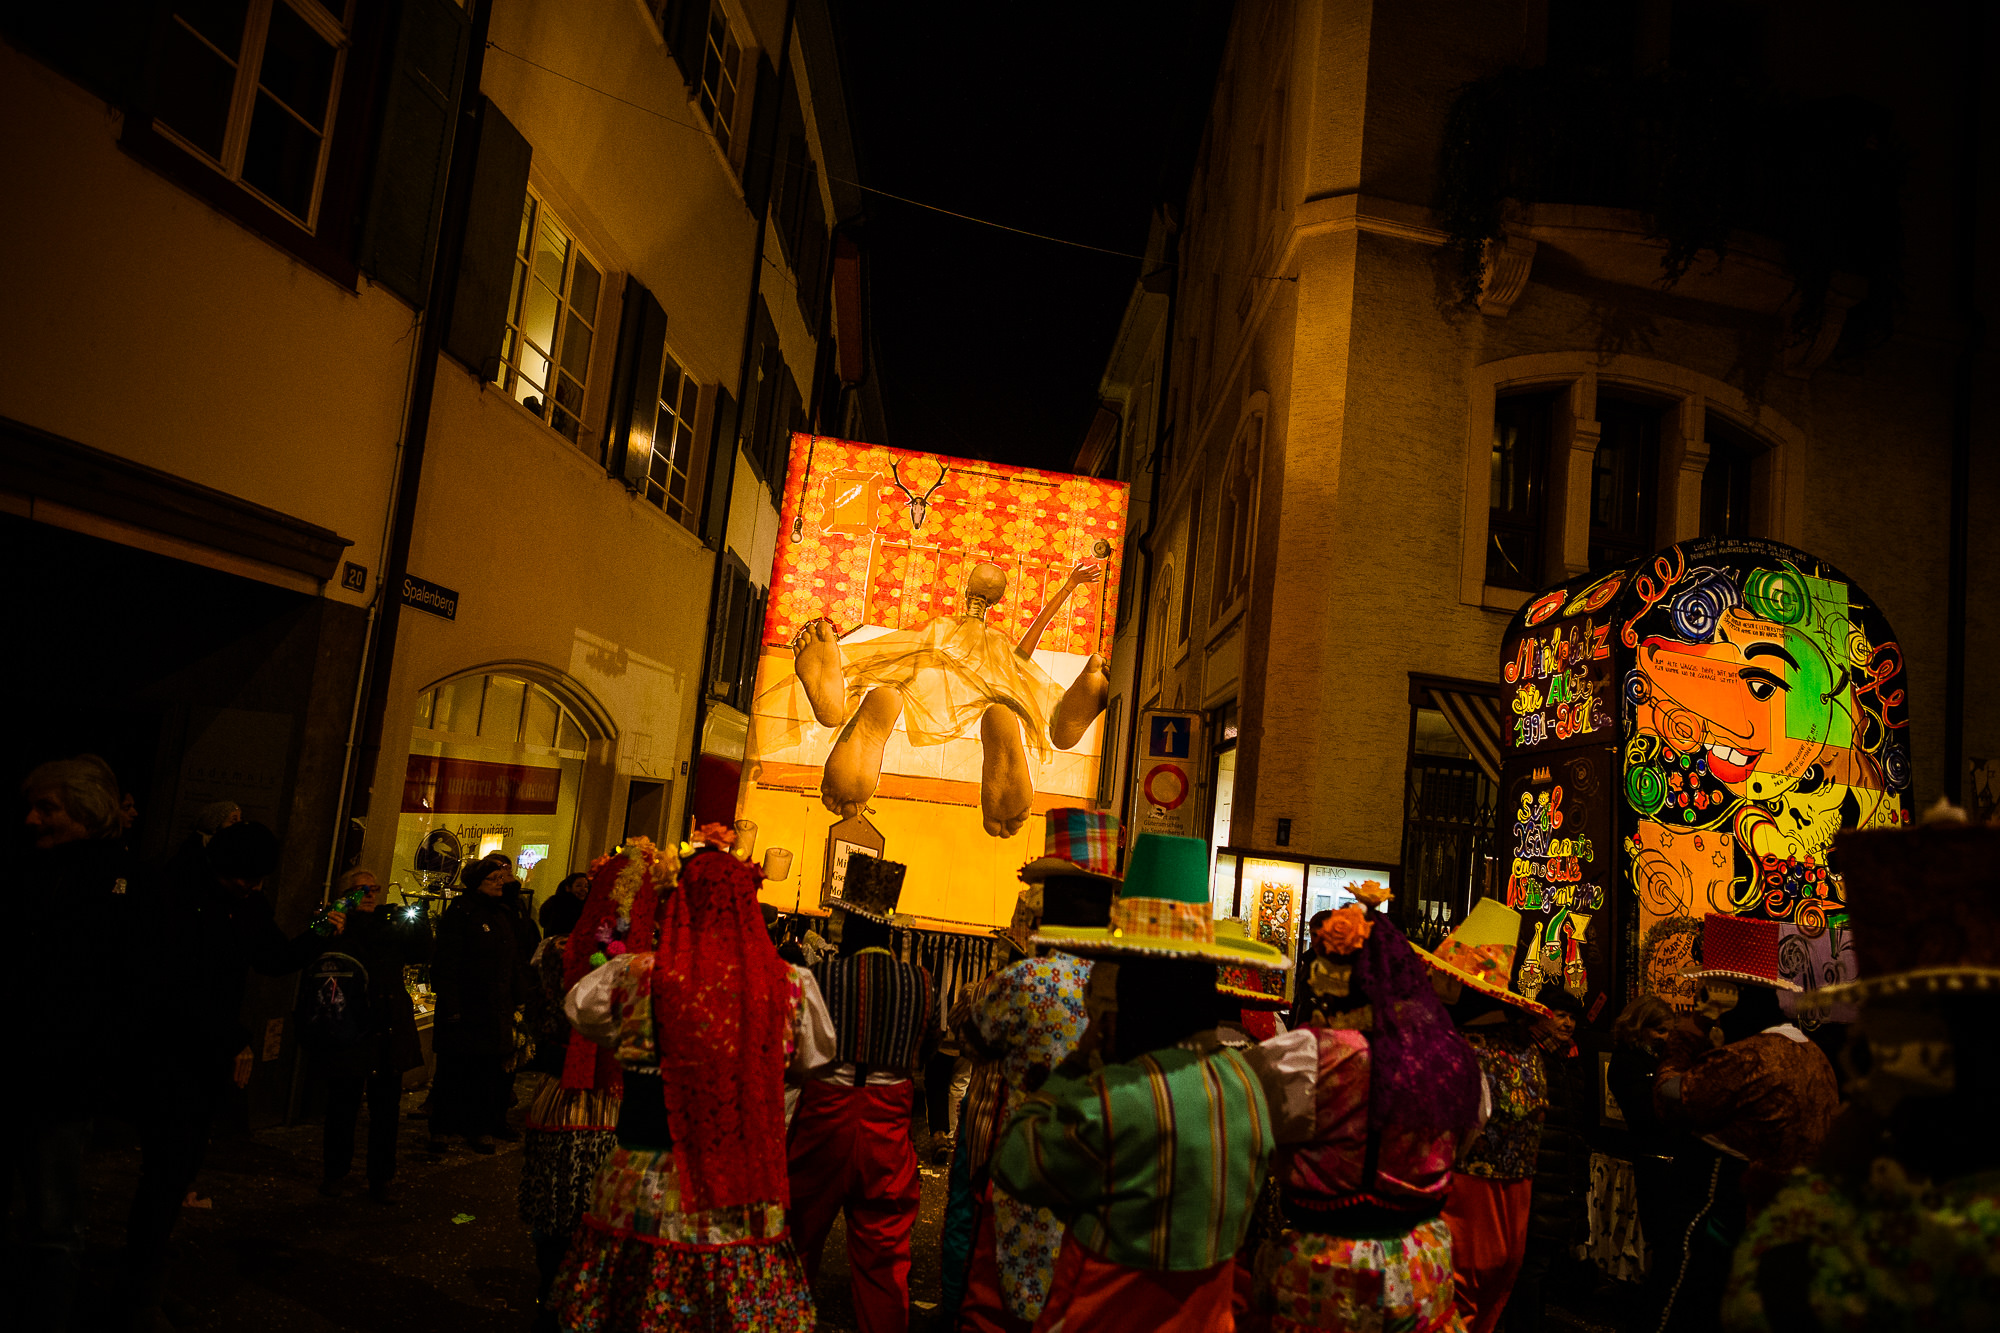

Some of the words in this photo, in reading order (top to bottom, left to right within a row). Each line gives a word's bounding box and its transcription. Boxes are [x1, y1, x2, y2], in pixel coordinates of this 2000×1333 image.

[349, 568, 364, 586] 20
[402, 578, 455, 616] Spalenberg
[1315, 867, 1346, 879] ETHNO
